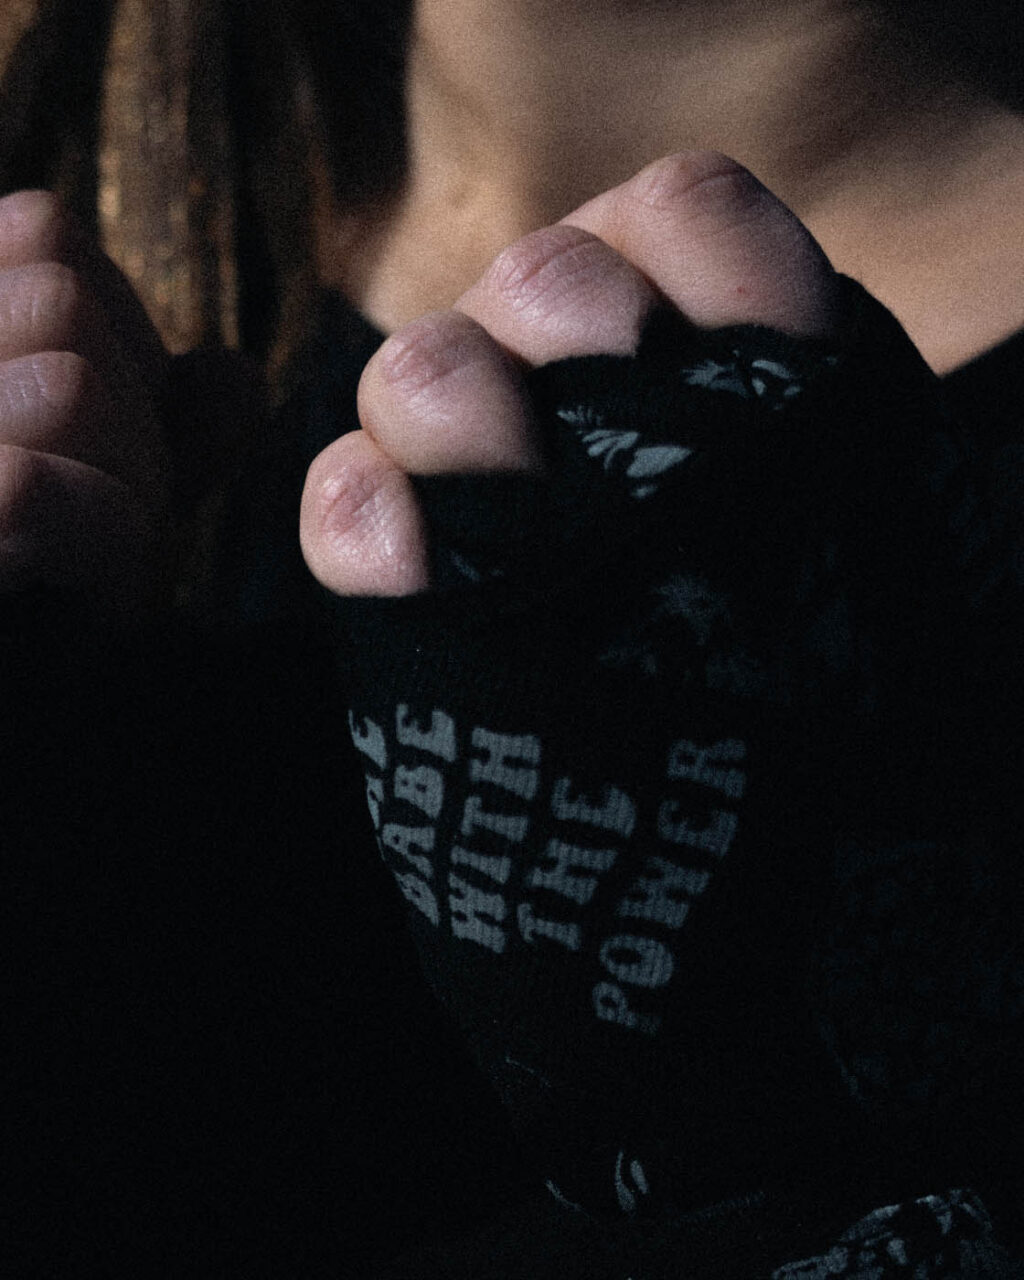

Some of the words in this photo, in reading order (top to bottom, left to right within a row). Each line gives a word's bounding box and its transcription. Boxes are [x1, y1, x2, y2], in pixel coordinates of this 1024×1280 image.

[381, 701, 458, 927] BABE
[448, 726, 543, 955] WITH
[516, 775, 638, 952] THE
[592, 736, 749, 1041] POWER
